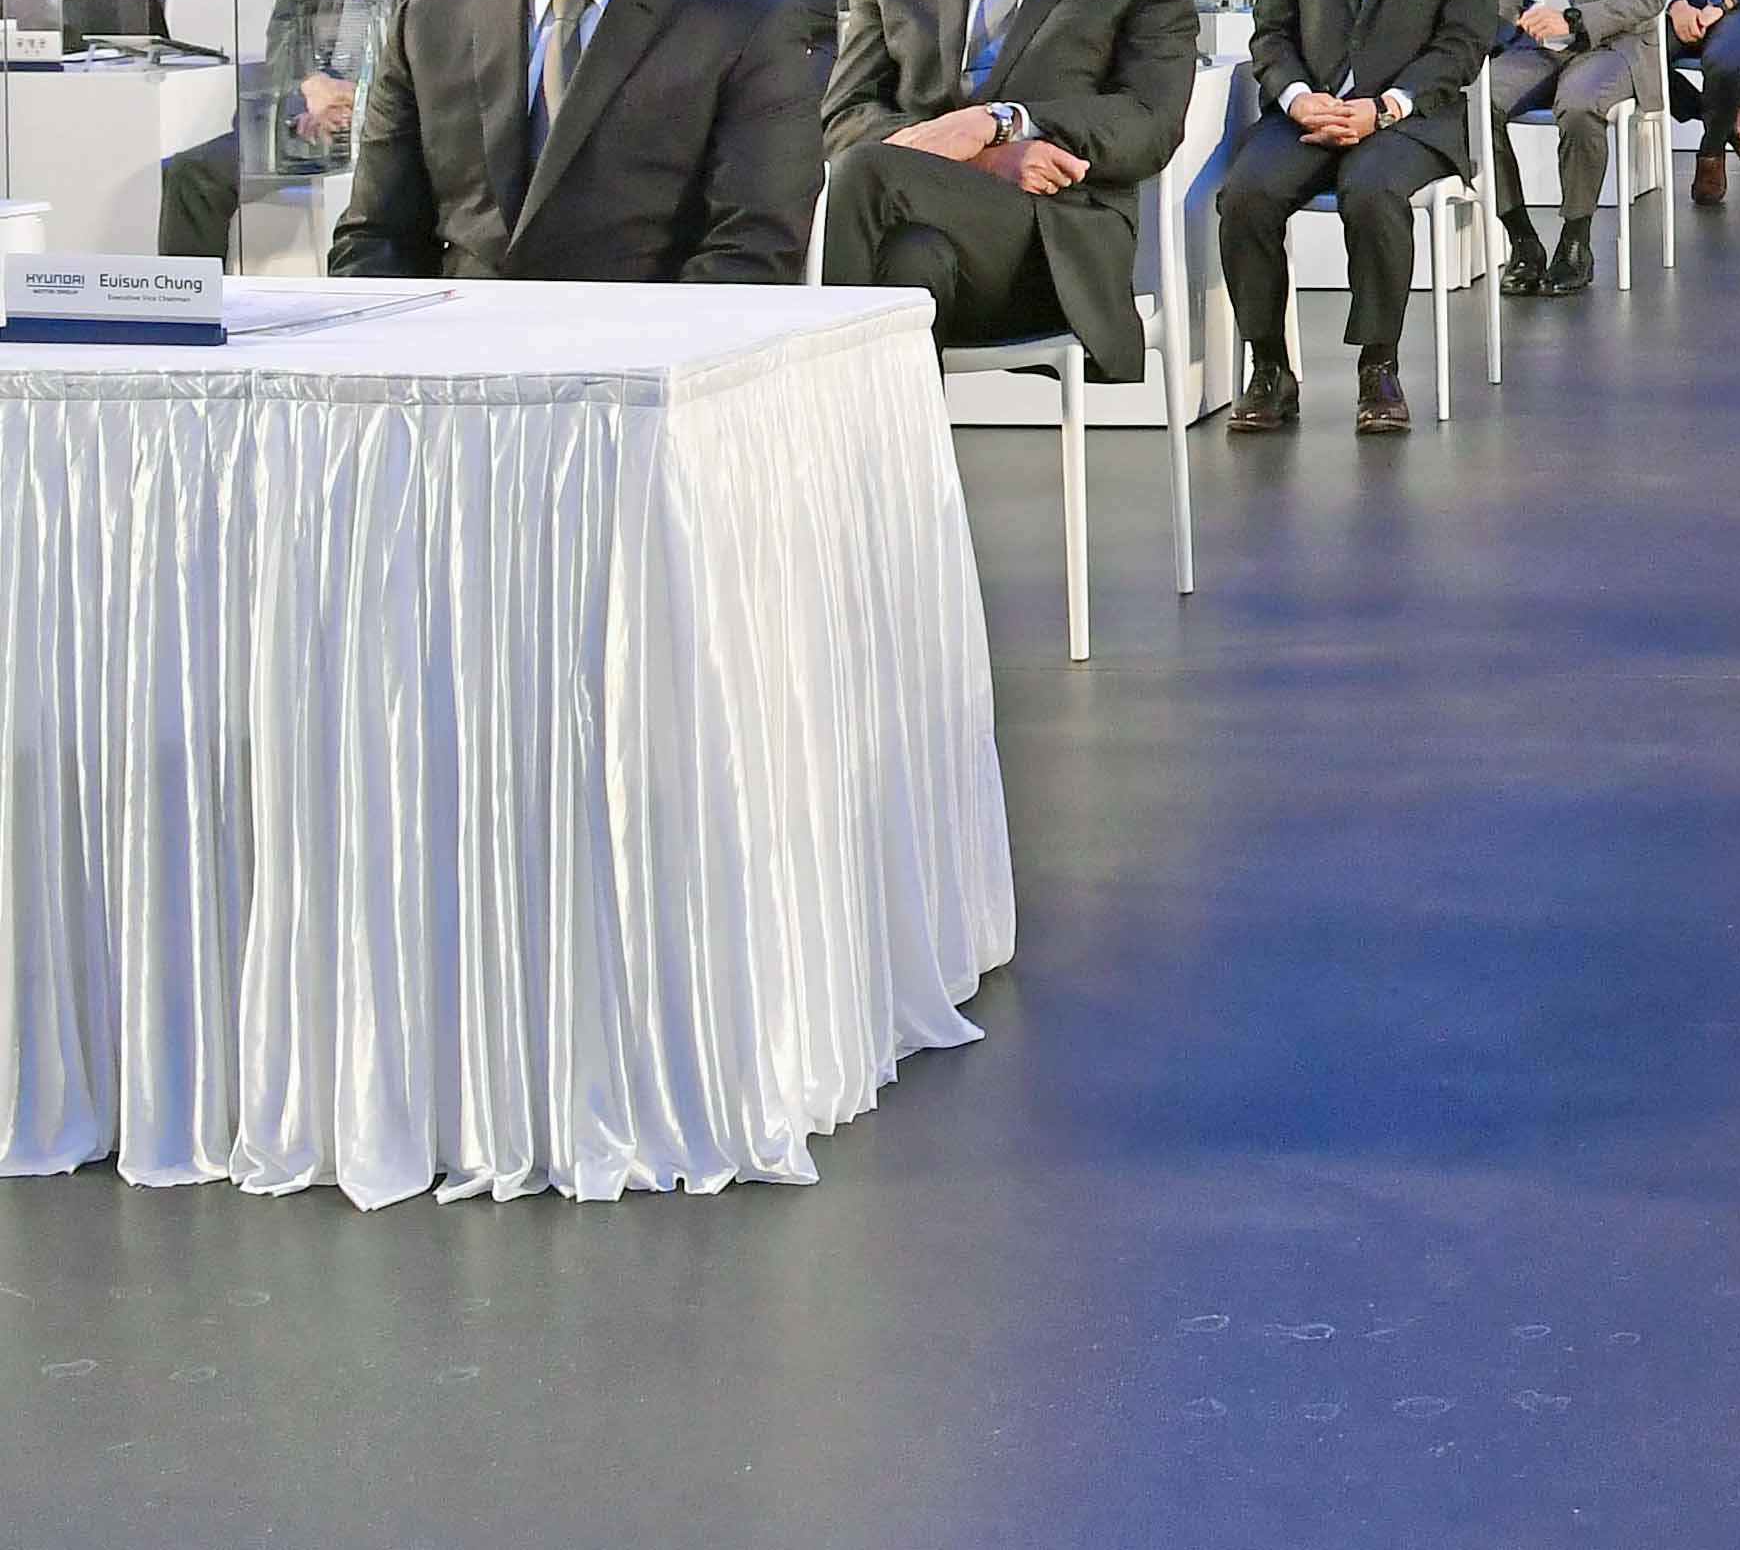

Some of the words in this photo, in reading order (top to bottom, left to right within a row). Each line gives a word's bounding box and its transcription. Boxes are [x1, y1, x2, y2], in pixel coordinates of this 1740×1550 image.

[26, 273, 85, 285] HYUNDAI
[99, 273, 149, 288] Euisun
[154, 275, 203, 293] Chung
